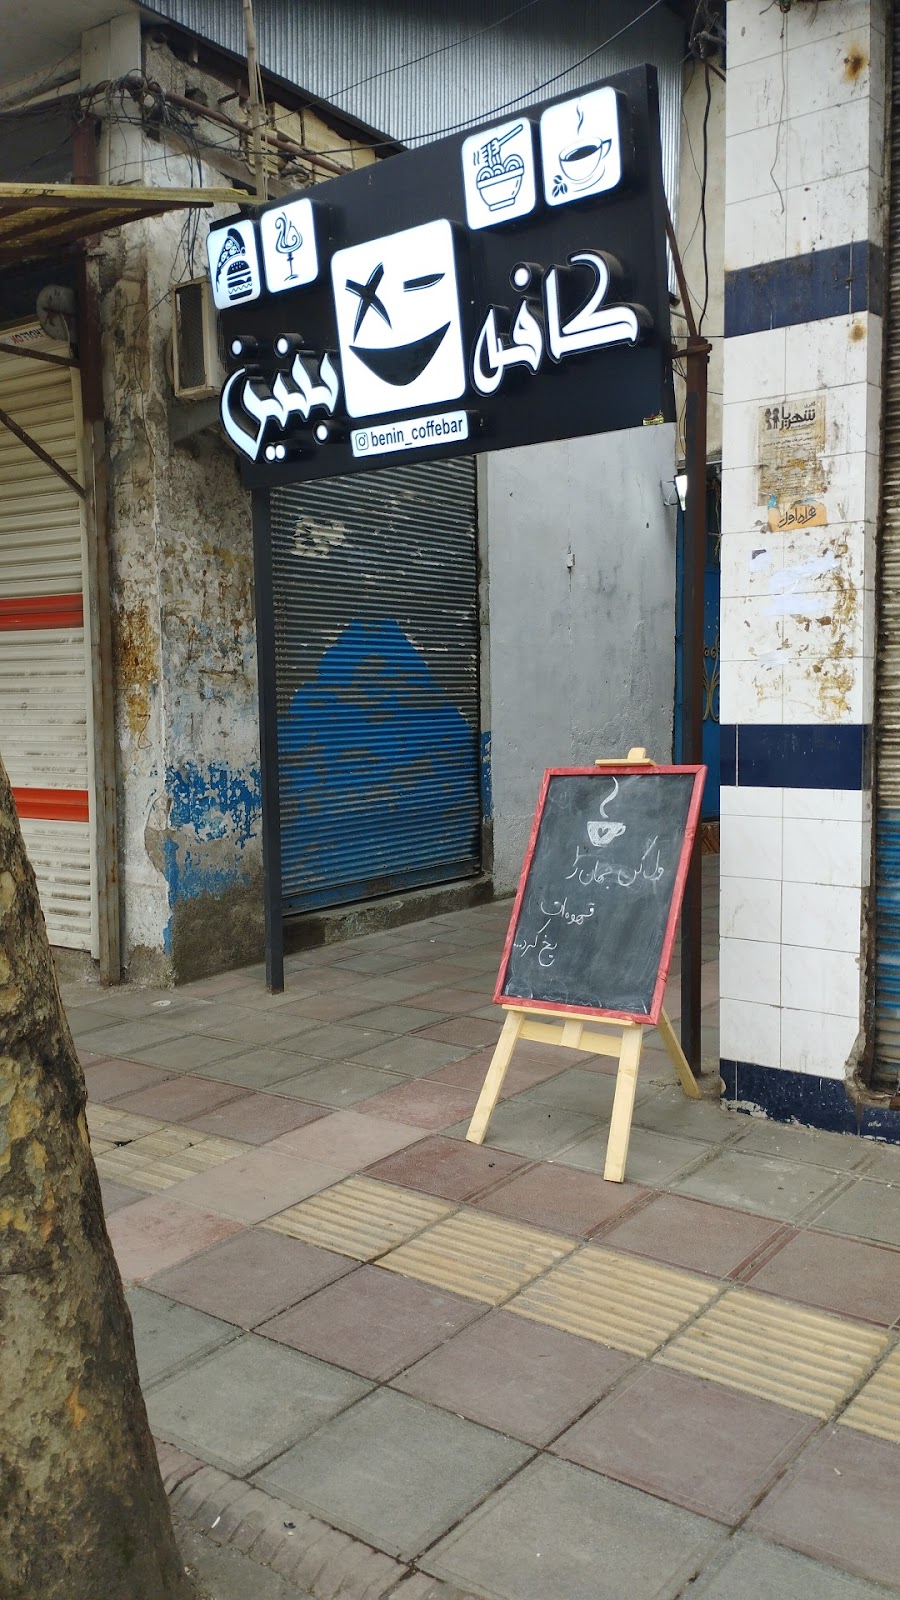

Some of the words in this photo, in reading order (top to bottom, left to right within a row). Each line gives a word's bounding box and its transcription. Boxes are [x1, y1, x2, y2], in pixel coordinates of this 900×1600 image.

[470, 248, 639, 396] کافه
[219, 337, 340, 463] بنین
[370, 415, 464, 449] benin_coffebar
[779, 406, 816, 431] شهریار
[578, 860, 612, 890] جهان
[617, 835, 659, 887] کن
[643, 849, 665, 881] ول
[538, 934, 558, 967] یخ
